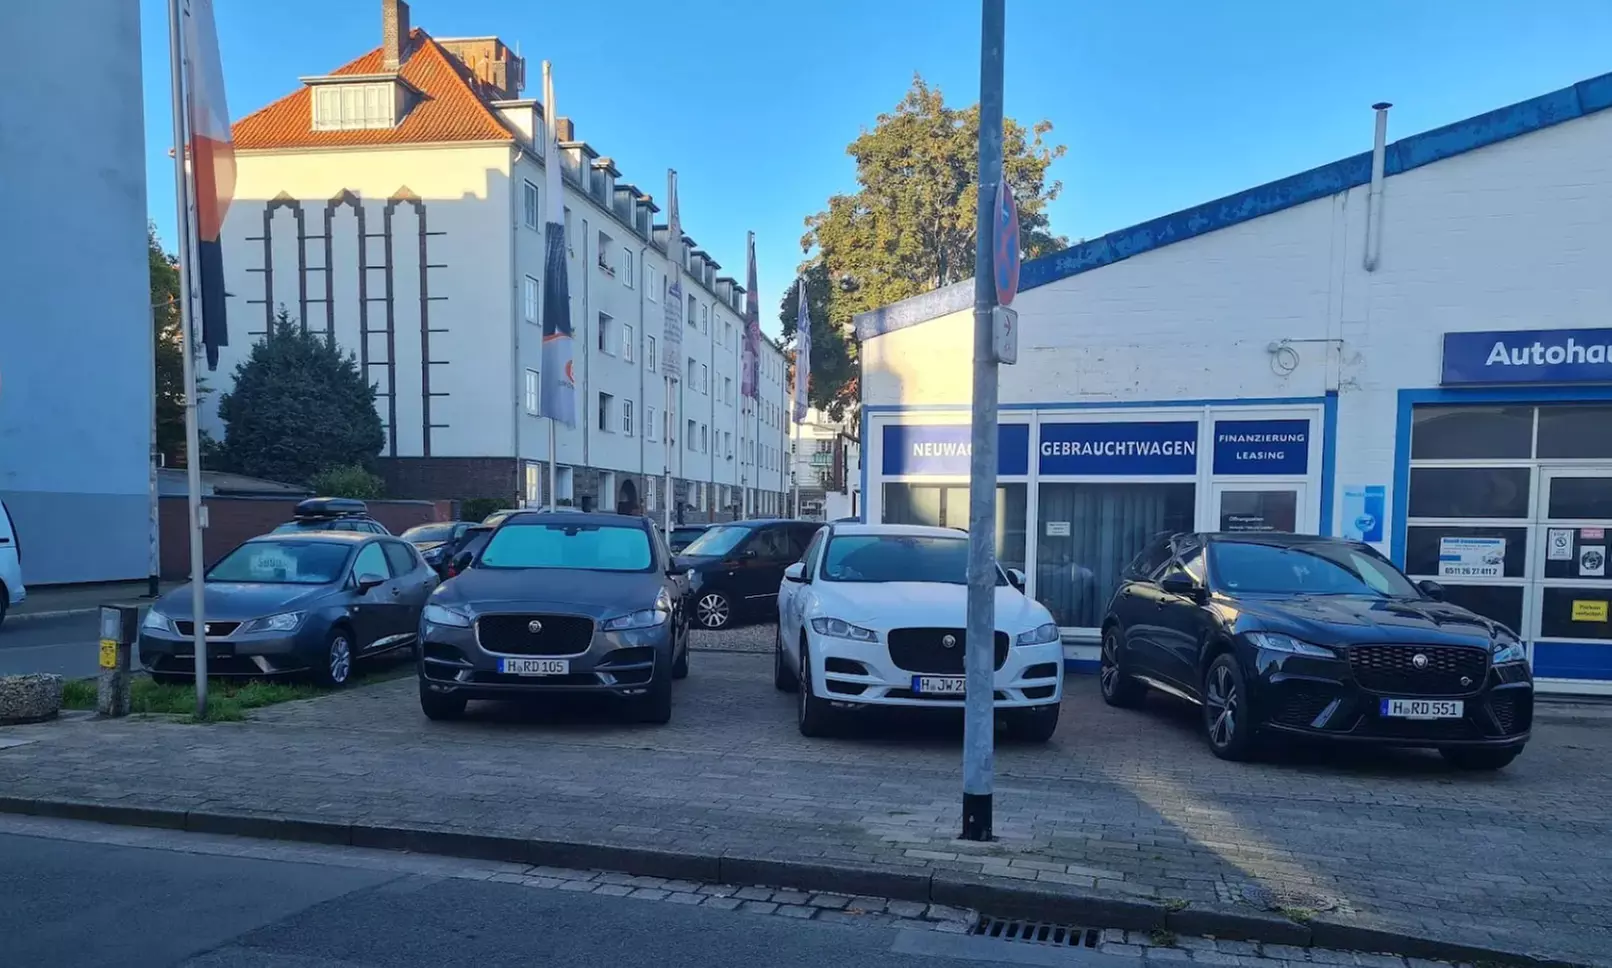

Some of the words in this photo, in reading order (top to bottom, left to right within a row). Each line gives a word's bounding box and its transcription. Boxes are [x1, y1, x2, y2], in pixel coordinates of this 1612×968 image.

[1219, 434, 1305, 442] FINANZIERUNG
[1041, 441, 1196, 456] GEBRAUCHTWAGEN
[1236, 451, 1285, 460] LEASING
[508, 660, 516, 672] H
[524, 661, 539, 672] RD
[542, 661, 564, 672] 105
[922, 679, 930, 690] H
[938, 680, 952, 690] JW
[1394, 702, 1402, 714] H
[1411, 702, 1428, 714] RD
[1432, 702, 1456, 715] 551
